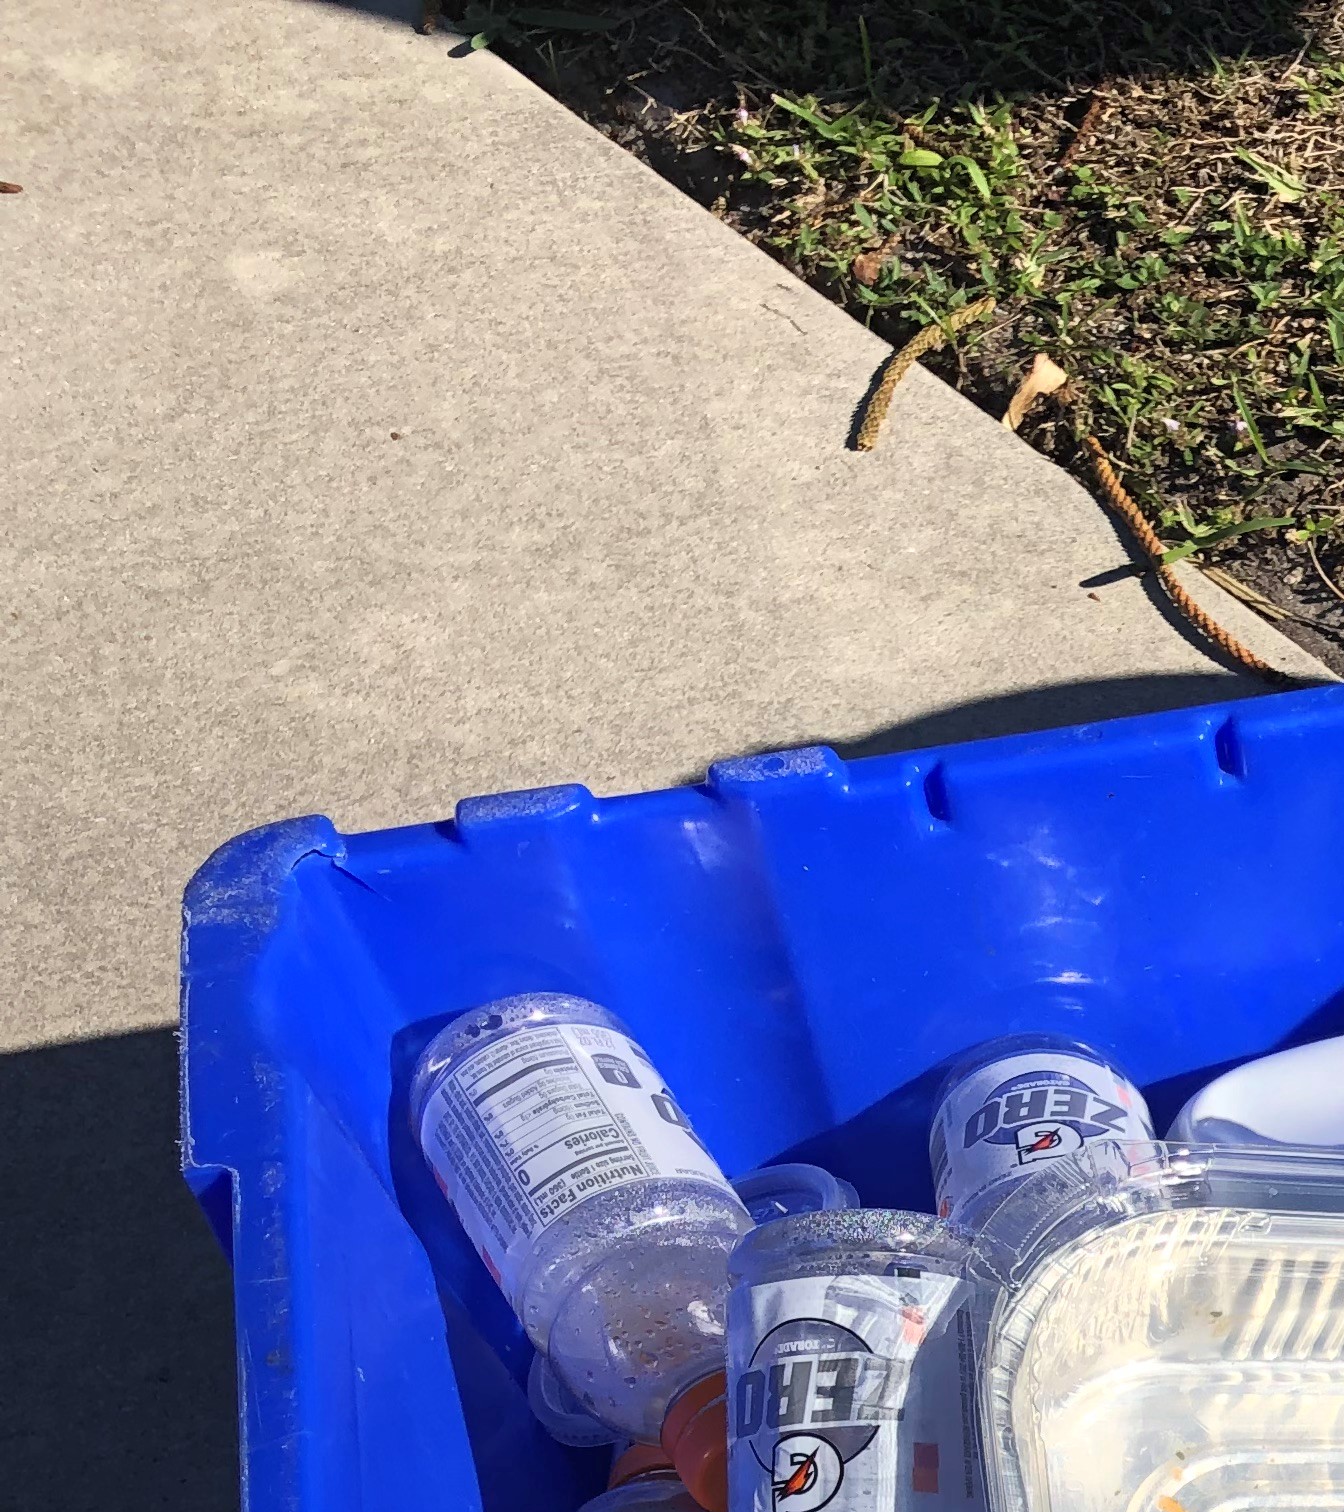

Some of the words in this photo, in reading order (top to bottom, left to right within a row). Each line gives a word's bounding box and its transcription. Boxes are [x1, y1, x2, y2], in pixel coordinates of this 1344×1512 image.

[531, 1093, 577, 1115] Carbohydrate
[575, 1091, 594, 1099] Total
[574, 1110, 587, 1119] Fat
[586, 1106, 605, 1115] Total
[963, 1089, 1129, 1149] ZERO
[563, 1125, 620, 1151] Calories
[594, 1158, 609, 1168] size
[608, 1152, 635, 1164] Serving
[515, 1167, 532, 1187] 0
[569, 1166, 590, 1181] Bottle
[576, 1163, 643, 1193] Nutrition
[538, 1187, 576, 1220] Facts
[735, 1356, 909, 1440] ZERO
